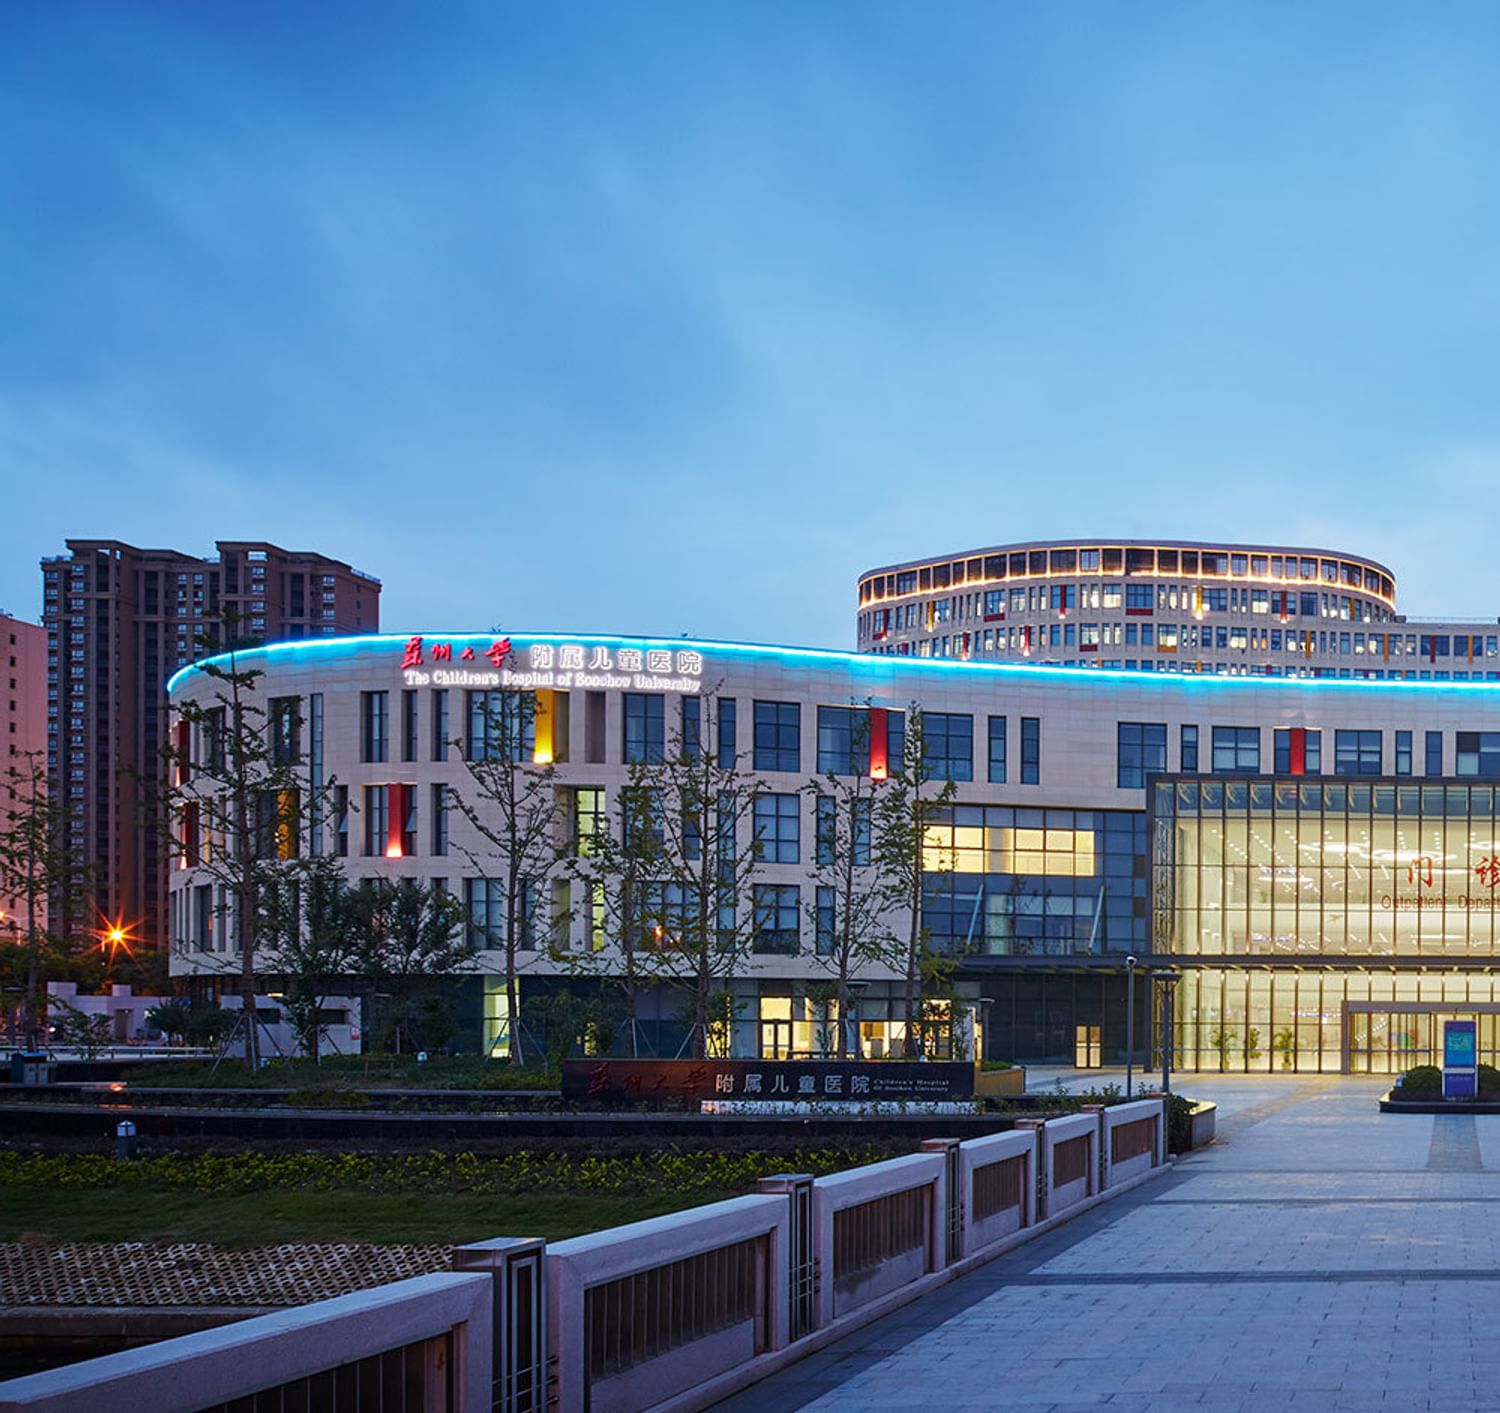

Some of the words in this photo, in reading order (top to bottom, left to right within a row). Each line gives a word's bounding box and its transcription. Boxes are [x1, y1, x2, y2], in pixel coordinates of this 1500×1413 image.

[530, 644, 702, 674] 附属儿童医院
[404, 670, 430, 686] The
[433, 671, 499, 686] Children's
[504, 671, 554, 687] Hospital
[557, 673, 572, 687] of
[574, 673, 631, 688] Soochow
[633, 675, 701, 692] University
[715, 1073, 870, 1095] 附属儿童医院
